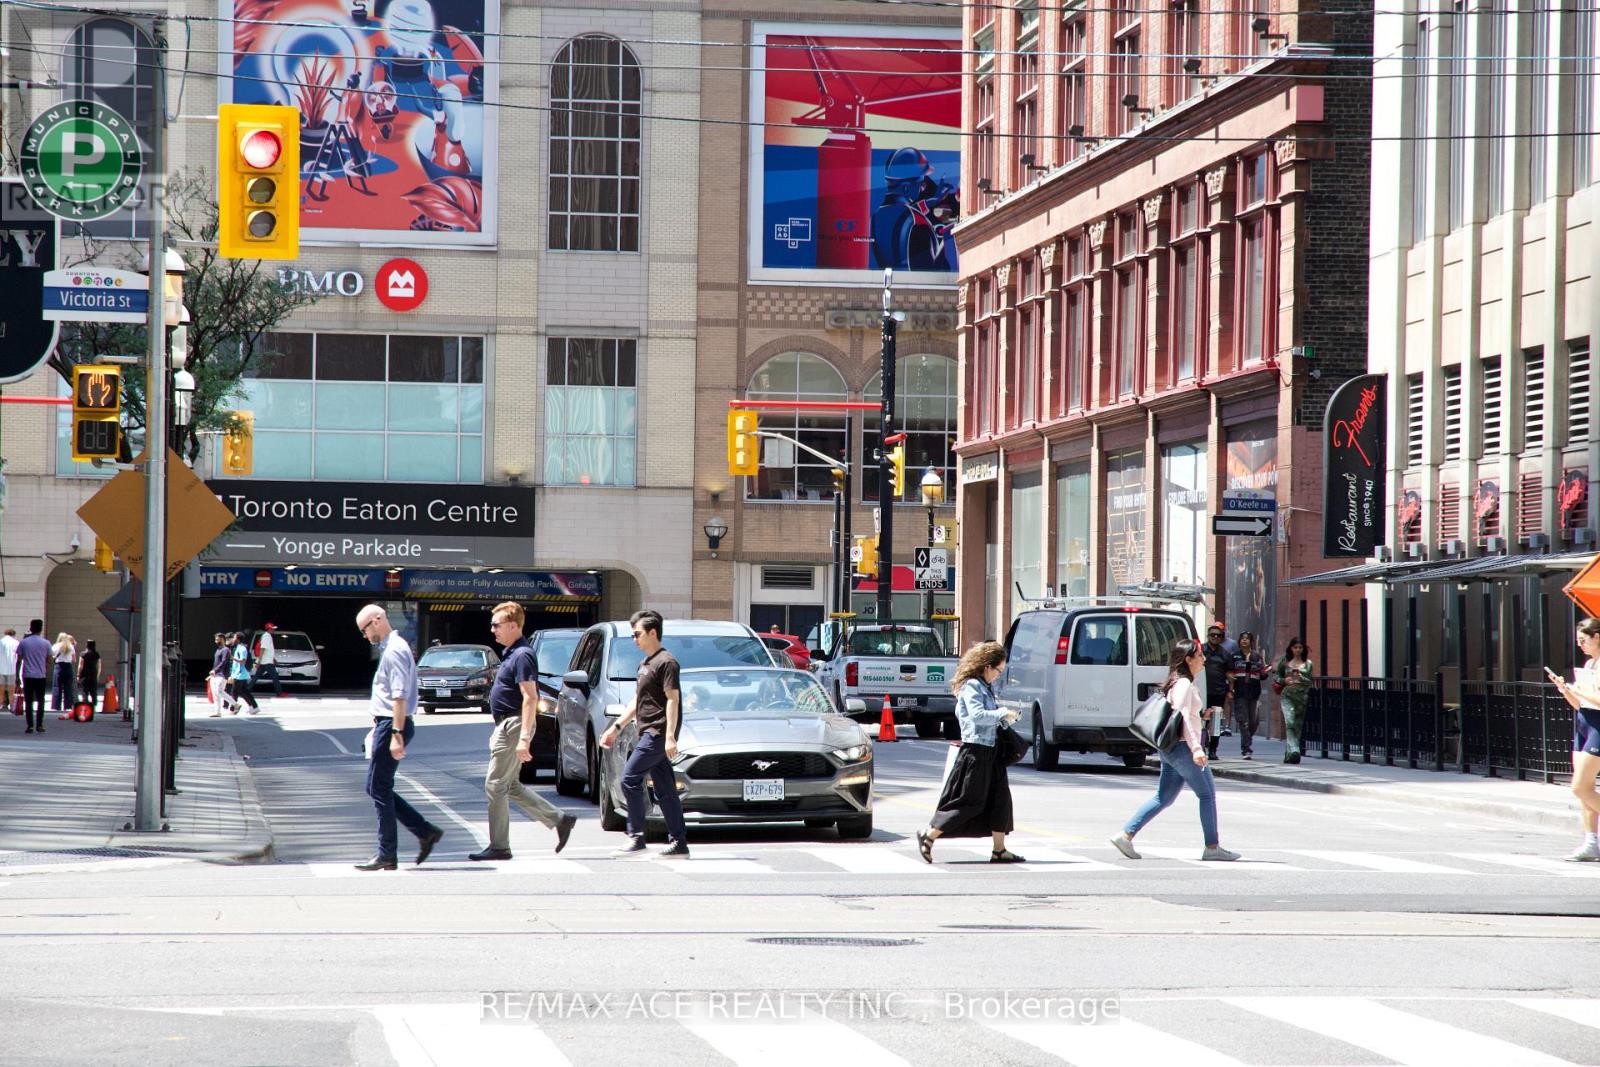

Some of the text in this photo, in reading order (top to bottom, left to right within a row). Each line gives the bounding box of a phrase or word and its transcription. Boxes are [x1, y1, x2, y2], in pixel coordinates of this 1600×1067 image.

[26, 106, 136, 159] MUNICIPAL
[61, 131, 106, 177] P
[26, 168, 134, 216] PARKING
[275, 269, 364, 296] BMO
[60, 290, 131, 308] Victoria St
[229, 495, 518, 523] Toronto Eaton Centre
[1229, 499, 1260, 509] O'Keefe
[1337, 472, 1358, 552] Restaurant
[1364, 479, 1374, 527] Since 1940
[272, 536, 422, 559] Yonge Parkade
[287, 573, 369, 587] NO ENTRY
[410, 577, 445, 587] Welcome
[447, 578, 456, 586] to
[473, 578, 491, 589] Fully
[494, 578, 535, 588] Automated
[919, 580, 944, 589] ENDS
